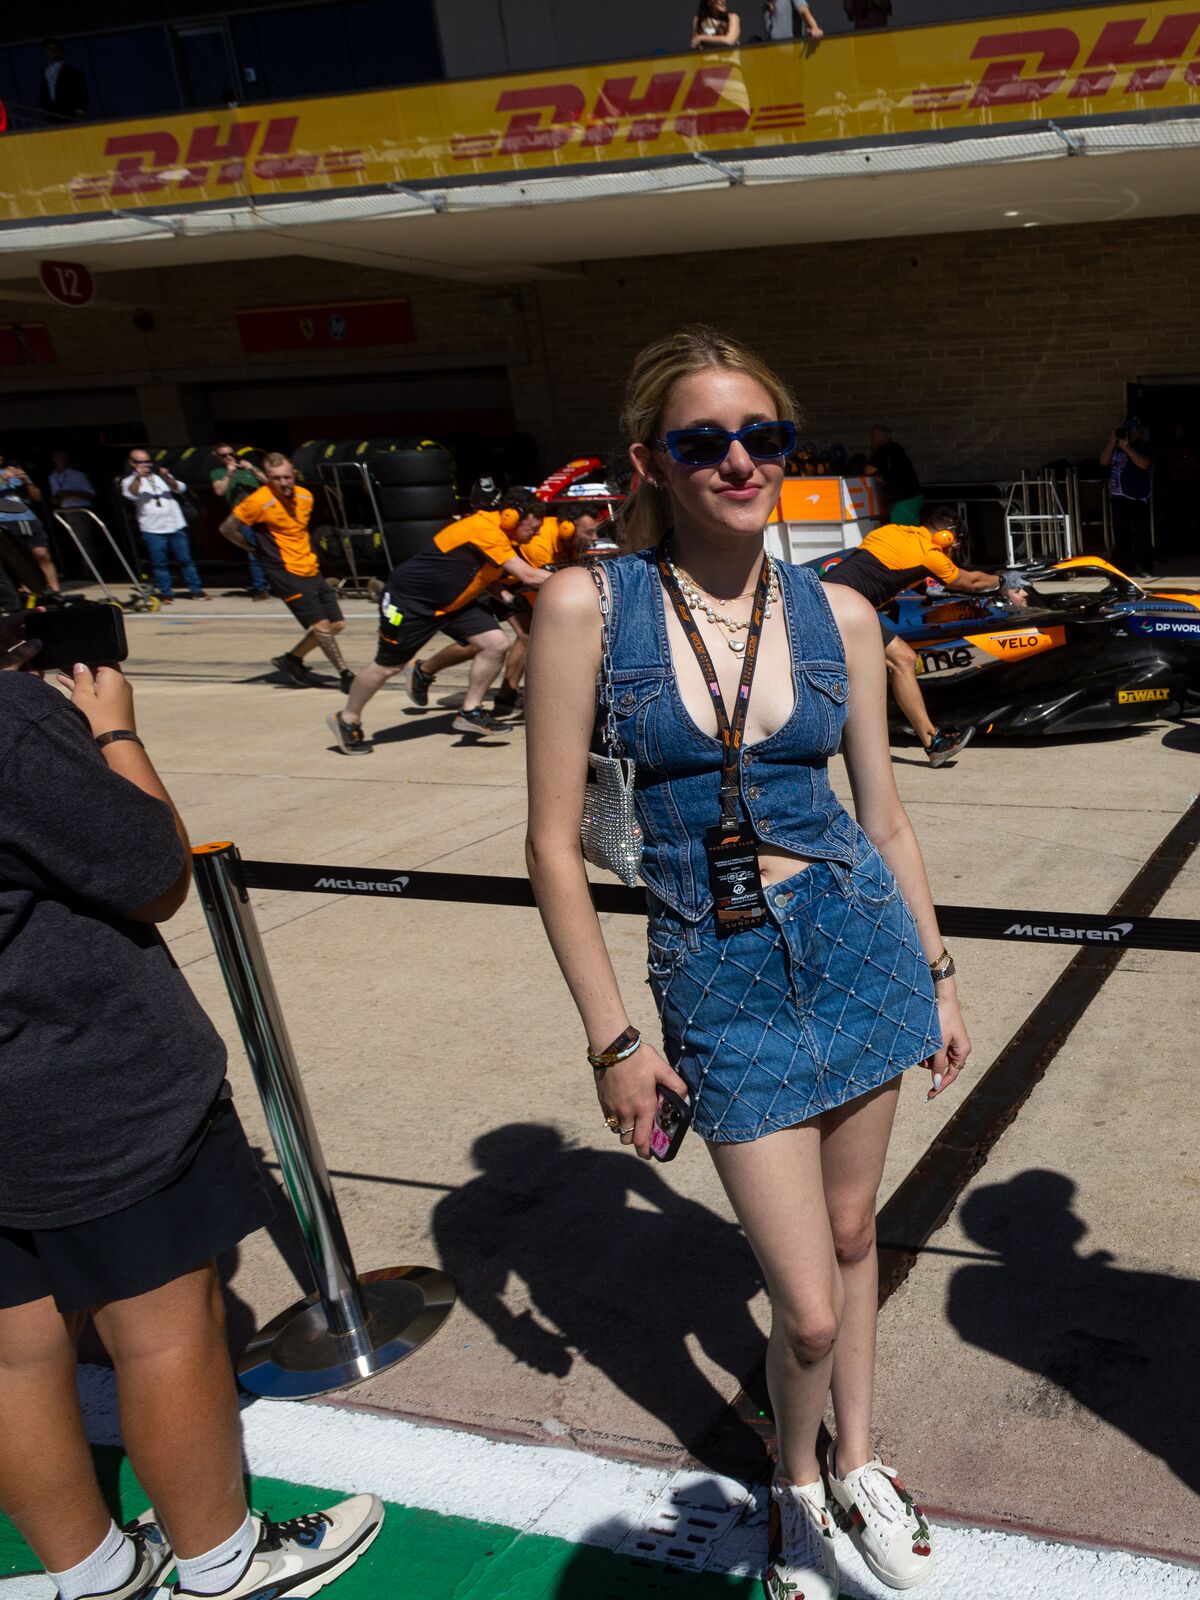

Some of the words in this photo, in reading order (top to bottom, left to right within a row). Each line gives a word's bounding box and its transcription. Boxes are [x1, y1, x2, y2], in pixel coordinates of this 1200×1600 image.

[496, 66, 751, 155] DHL
[103, 116, 320, 195] DHL
[53, 266, 83, 297] 12
[1155, 622, 1171, 632] DP
[997, 636, 1038, 650] VELO
[916, 648, 974, 673] me
[314, 876, 402, 893] McLaren
[726, 918, 761, 928] SUNDAY
[1002, 923, 1122, 942] McLaren
